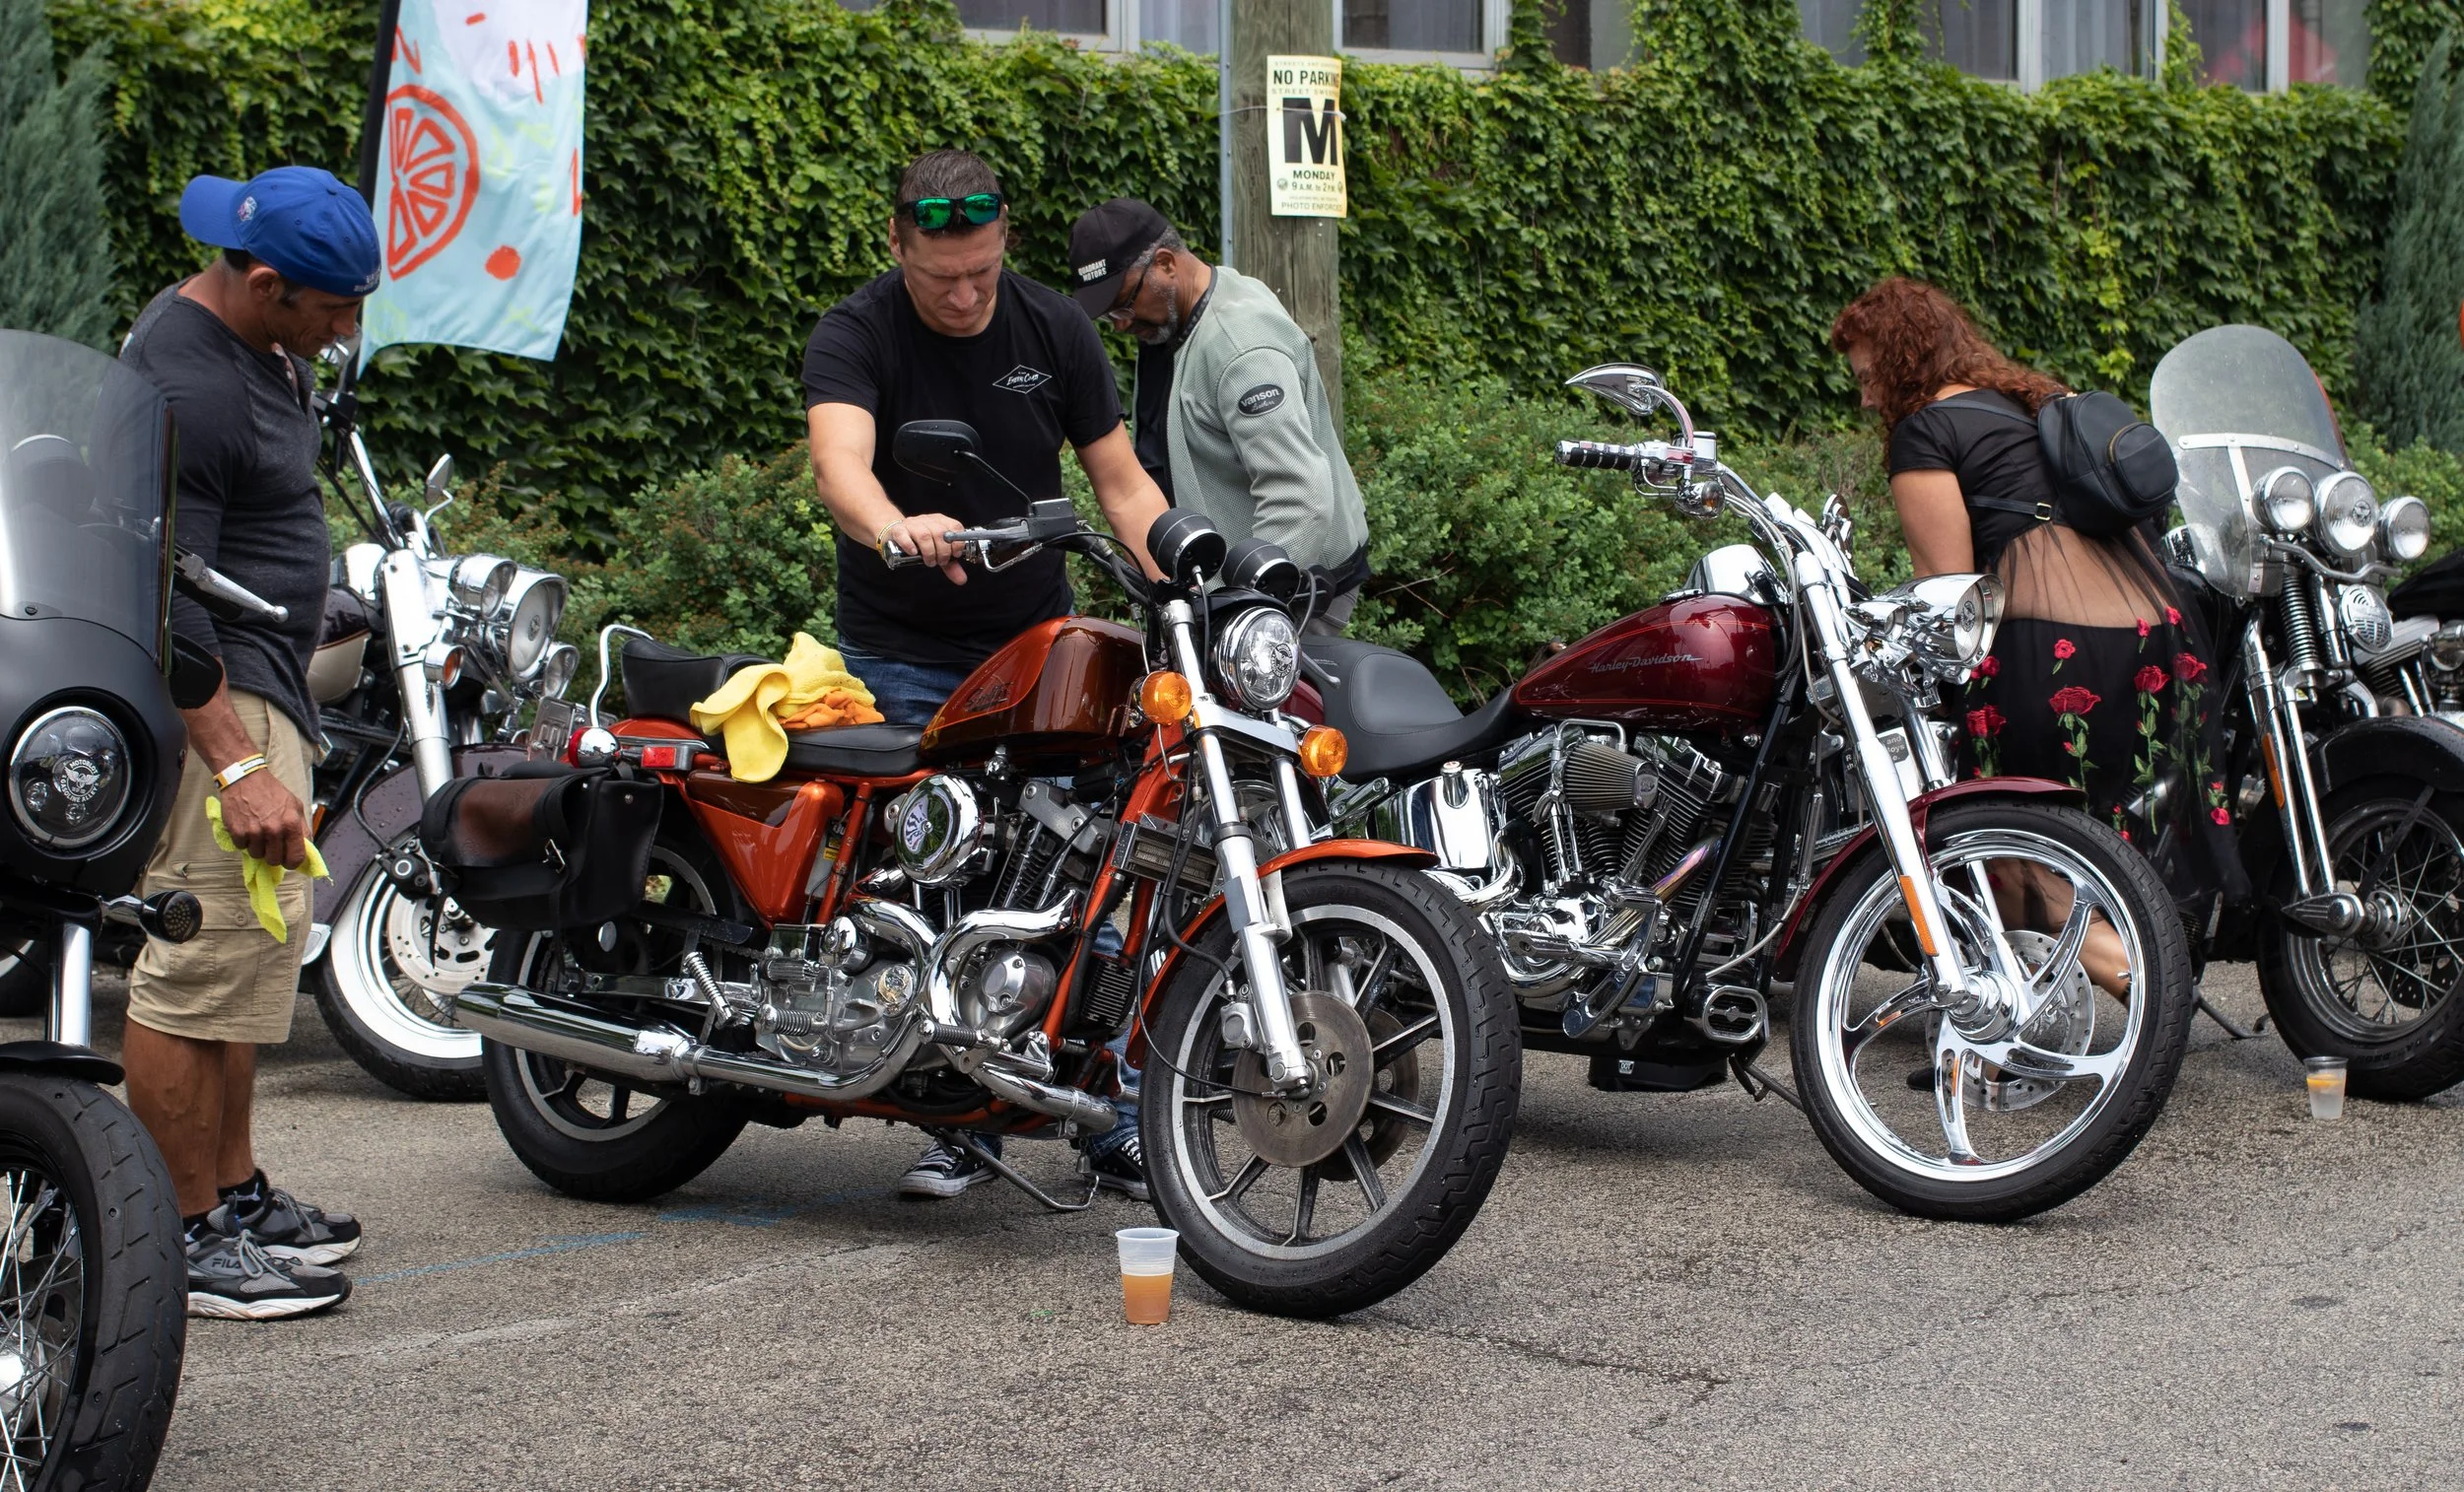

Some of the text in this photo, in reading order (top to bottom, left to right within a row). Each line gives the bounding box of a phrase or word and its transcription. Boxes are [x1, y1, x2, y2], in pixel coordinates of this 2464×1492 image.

[1273, 69, 1339, 89] NO PARKING
[1282, 98, 1337, 166] M
[1292, 170, 1335, 181] MONDAY
[1291, 181, 1298, 190] 9
[1281, 201, 1310, 210] PHOTO
[1077, 258, 1106, 276] QUADRANT
[1083, 267, 1107, 282] MOTORS
[1241, 388, 1280, 407] vanson
[1586, 653, 1703, 673] Harley-Davidson
[1886, 735, 1902, 745] and
[69, 759, 99, 774] MOTOBLOT
[212, 1257, 241, 1269] FILA
